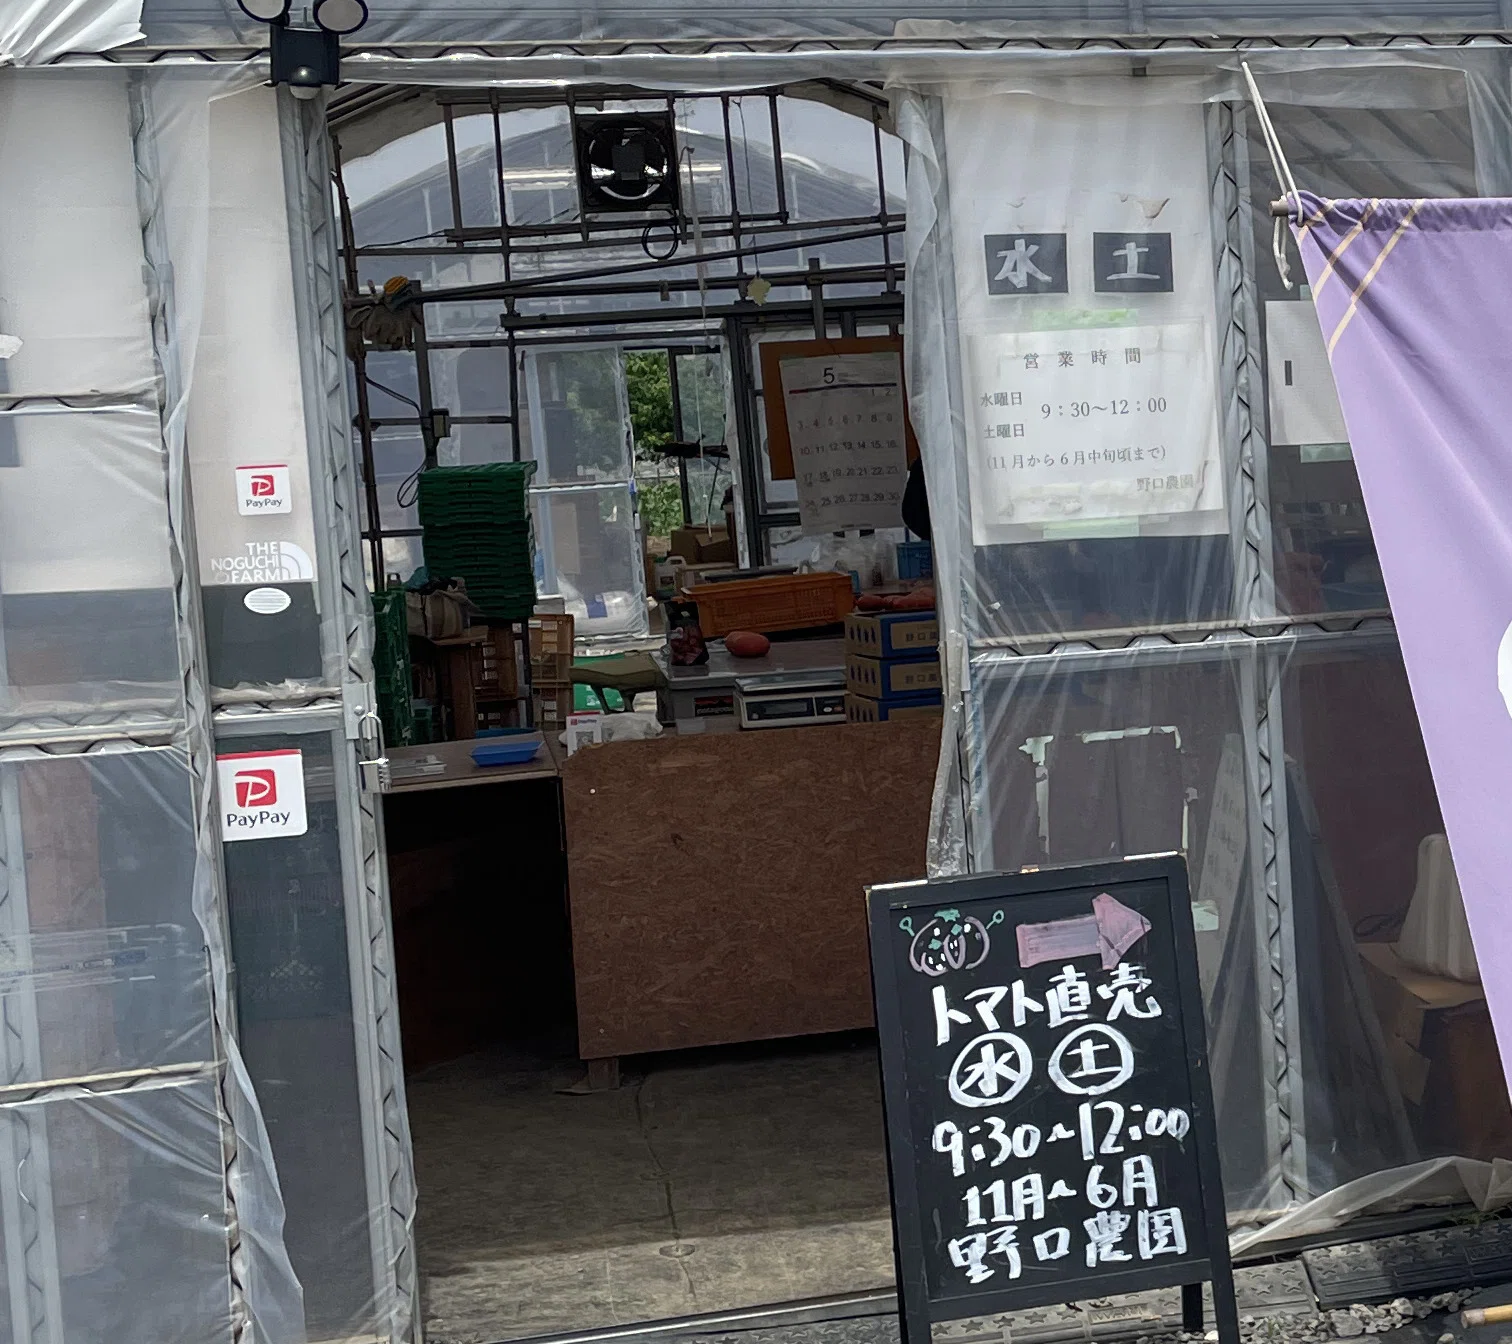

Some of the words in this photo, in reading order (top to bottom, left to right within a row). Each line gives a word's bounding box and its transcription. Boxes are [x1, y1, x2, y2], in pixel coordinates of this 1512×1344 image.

[993, 238, 1053, 288] 水
[1106, 241, 1161, 281] 土
[980, 391, 1023, 407] 水曜日
[983, 423, 1025, 439] 土曜日
[1136, 474, 1194, 492] 野口農園
[245, 497, 283, 509] PayPay
[245, 542, 279, 555] THE
[211, 555, 280, 571] NOGUCHI
[231, 568, 281, 584] FARM
[226, 809, 291, 829] PayPay
[931, 962, 1163, 1047] トマト直売
[947, 1206, 1187, 1284] 野口農園
